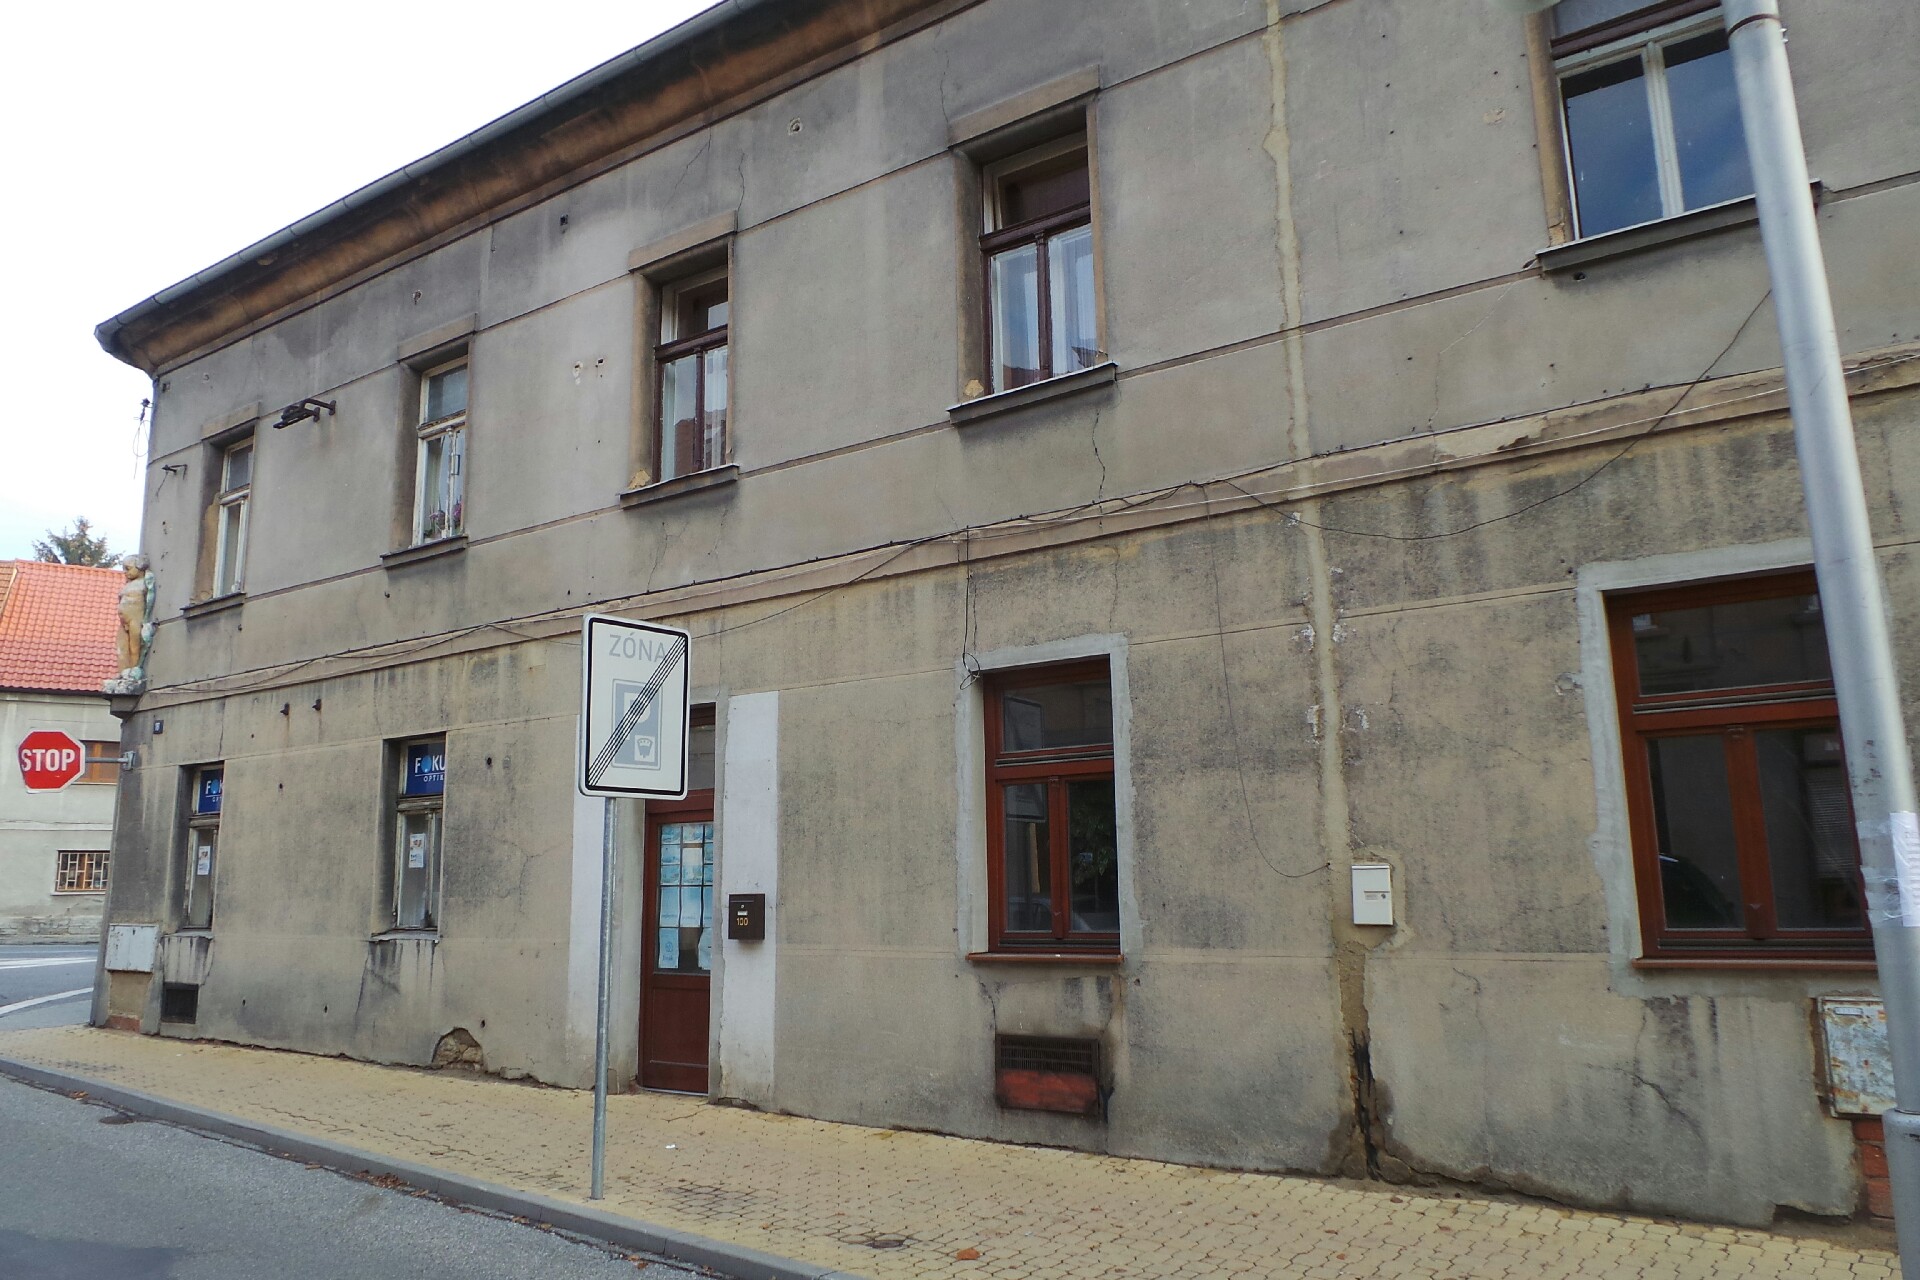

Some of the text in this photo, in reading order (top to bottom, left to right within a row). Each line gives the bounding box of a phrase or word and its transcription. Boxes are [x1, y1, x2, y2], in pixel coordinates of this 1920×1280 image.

[608, 632, 666, 663] ZÓNA
[21, 748, 76, 772] STOP
[736, 917, 749, 926] 100
